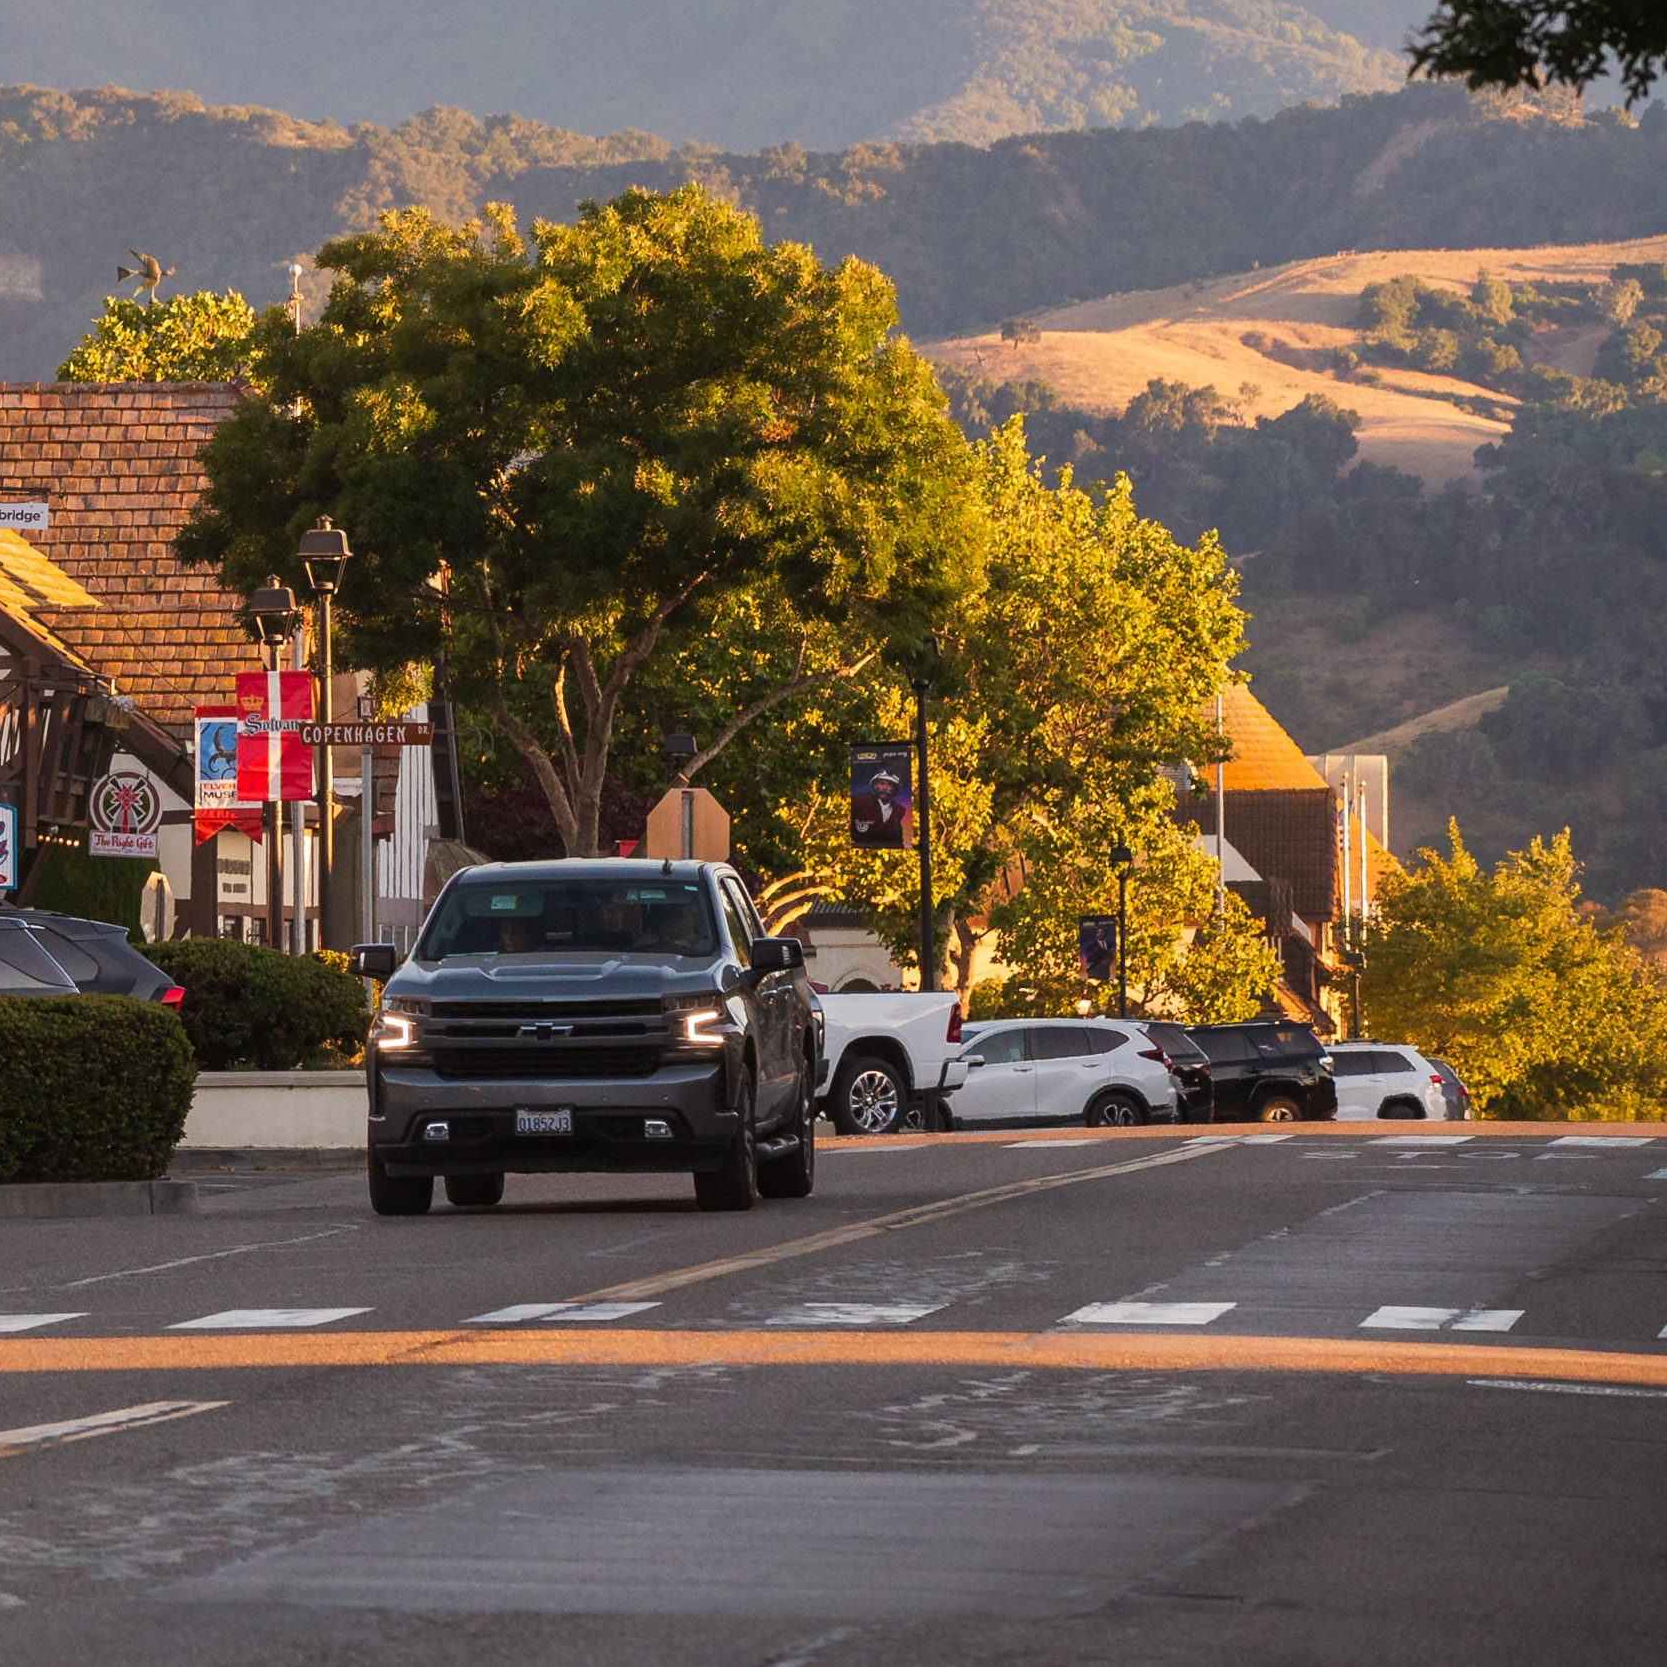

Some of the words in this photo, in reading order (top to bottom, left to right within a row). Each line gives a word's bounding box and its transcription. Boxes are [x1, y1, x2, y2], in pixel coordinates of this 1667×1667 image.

[242, 713, 306, 736] Solvan
[302, 725, 407, 744] COPENHAGEN
[418, 725, 430, 735] DR.
[95, 834, 110, 846] The
[112, 835, 135, 850] Right
[136, 836, 154, 850] Gift
